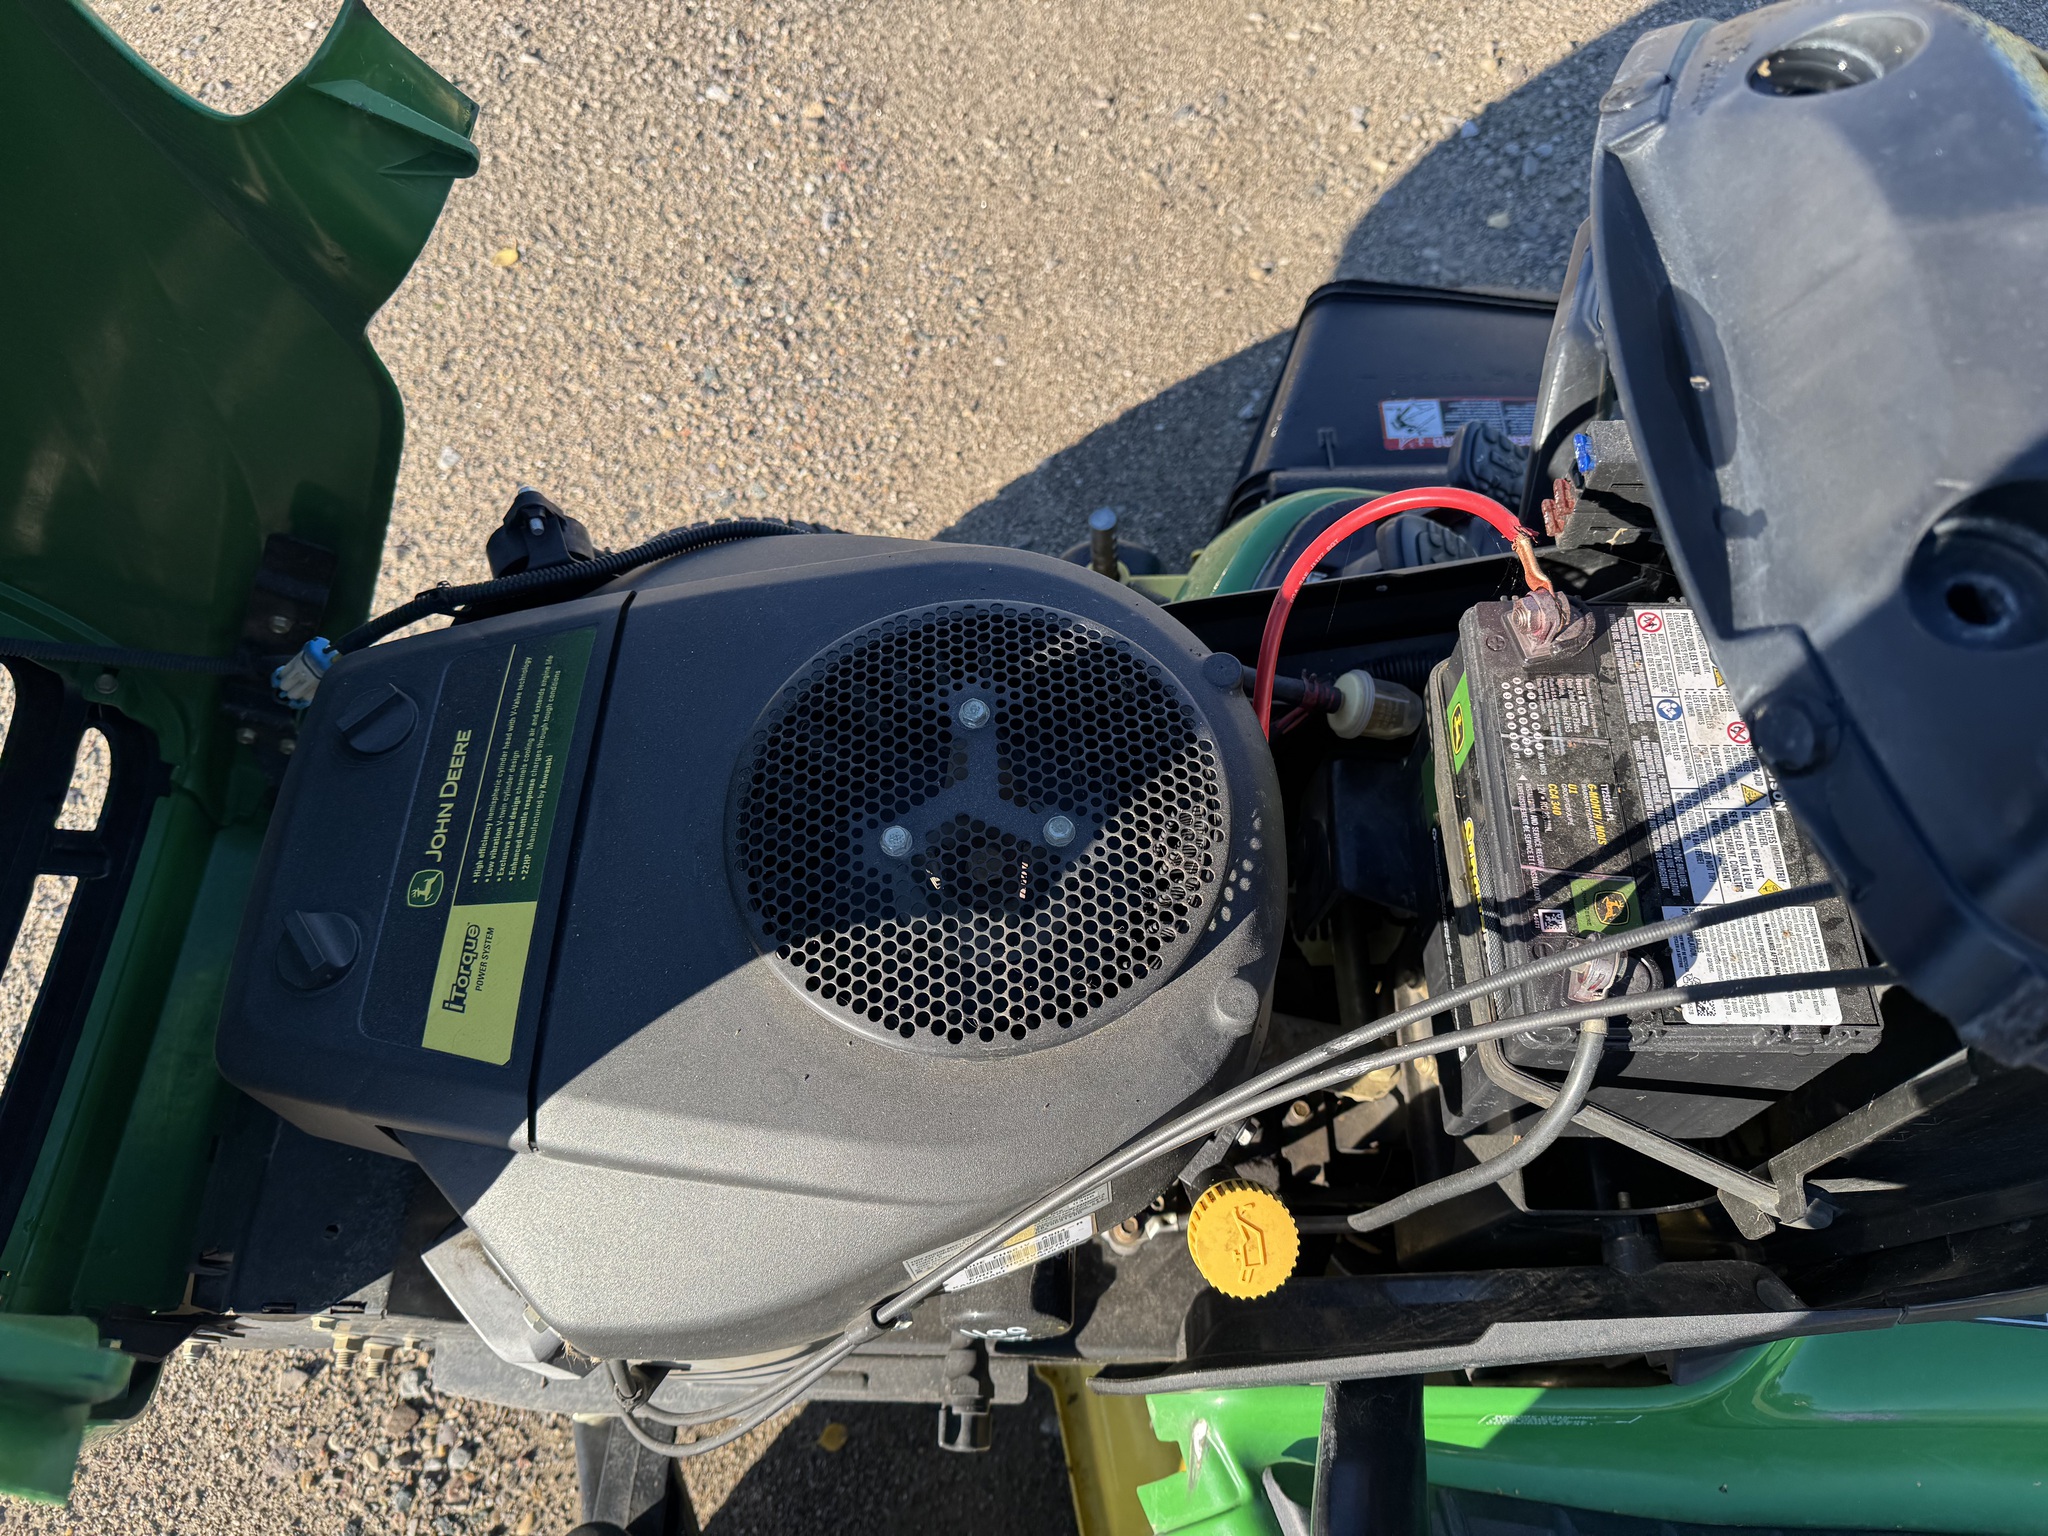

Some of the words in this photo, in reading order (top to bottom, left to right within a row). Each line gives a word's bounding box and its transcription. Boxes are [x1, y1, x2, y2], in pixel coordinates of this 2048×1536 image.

[1656, 633, 1665, 645] KEEP
[544, 655, 553, 664] life
[1646, 658, 1655, 666] DES
[1689, 652, 1698, 660] LES
[516, 657, 532, 690] technology
[540, 666, 552, 686] engine
[1648, 667, 1660, 689] ENFANTS.
[1690, 662, 1701, 676] YEUX.
[547, 670, 561, 701] conditions
[510, 692, 522, 715] V-Valve
[533, 688, 545, 712] extends
[1716, 695, 1726, 712] FLAMES
[530, 714, 539, 726] and
[542, 703, 554, 721] tough
[1577, 701, 1590, 726] Company
[506, 717, 516, 731] with
[528, 728, 536, 736] air
[1562, 717, 1572, 732] 61265
[1665, 721, 1675, 731] LIRE
[1674, 720, 1684, 733] READ
[502, 733, 512, 748] head
[536, 723, 550, 748] through
[1657, 721, 1672, 756] INSTRUCTIONS.
[1668, 732, 1679, 750] TOUTES
[1677, 734, 1686, 742] ALL
[522, 738, 535, 761] cooling
[1672, 751, 1681, 760] LES
[1738, 747, 1747, 756] CAN
[438, 729, 472, 797] DEERE
[495, 751, 509, 776] cylinder
[508, 750, 521, 772] design
[529, 750, 543, 776] charges
[1680, 745, 1695, 780] INSTRUCTIONS.
[514, 763, 528, 793] channels
[538, 755, 553, 788] Kawasaki
[1752, 773, 1763, 785] ACID
[501, 774, 515, 801] cylinder
[523, 778, 537, 809] response
[537, 790, 546, 798] by
[1536, 783, 1545, 793] 12V
[1547, 783, 1558, 798] CCA
[1567, 783, 1577, 793] U1
[485, 779, 503, 820] hemispheric
[509, 796, 522, 819] design
[1550, 800, 1561, 815] 340
[1675, 800, 1684, 809] PAS
[1683, 800, 1692, 809] PAS
[495, 803, 508, 825] V-twin
[1529, 814, 1538, 825] AND
[1586, 783, 1602, 818] 6-MONTH
[1594, 824, 1607, 844] MOIS
[1693, 812, 1704, 824] OPEN
[1740, 811, 1751, 820] GET
[1761, 811, 1773, 828] FLUSH
[423, 803, 454, 861] JOHN
[504, 821, 515, 838] hood
[516, 811, 529, 837] throttle
[525, 800, 544, 849] Manufactured
[476, 822, 493, 858] efficiency
[488, 827, 502, 859] vibration
[1523, 834, 1534, 853] SERVICE
[1531, 826, 1542, 846] SERVICE
[1743, 822, 1757, 847] MEDICAL
[1756, 826, 1768, 847] WATER.
[1765, 829, 1777, 843] EYES
[1734, 841, 1744, 850] LES
[496, 841, 511, 875] Exclusive
[507, 839, 523, 874] Enhanced
[520, 854, 532, 874] 22HP
[1703, 851, 1712, 859] DO
[1737, 851, 1748, 865] YEUX
[1749, 848, 1760, 862] HELP
[1769, 844, 1786, 882] IMMEDIATELY
[472, 860, 484, 877] High
[484, 861, 495, 876] Low
[1705, 860, 1714, 870] NOT
[1753, 864, 1764, 879] FAST.
[1742, 873, 1753, 888] L'EAU
[1805, 908, 1818, 937] PROPOSITION
[480, 927, 496, 959] SYSTEM
[442, 924, 480, 1013] iTorque
[473, 961, 488, 991] POWER
